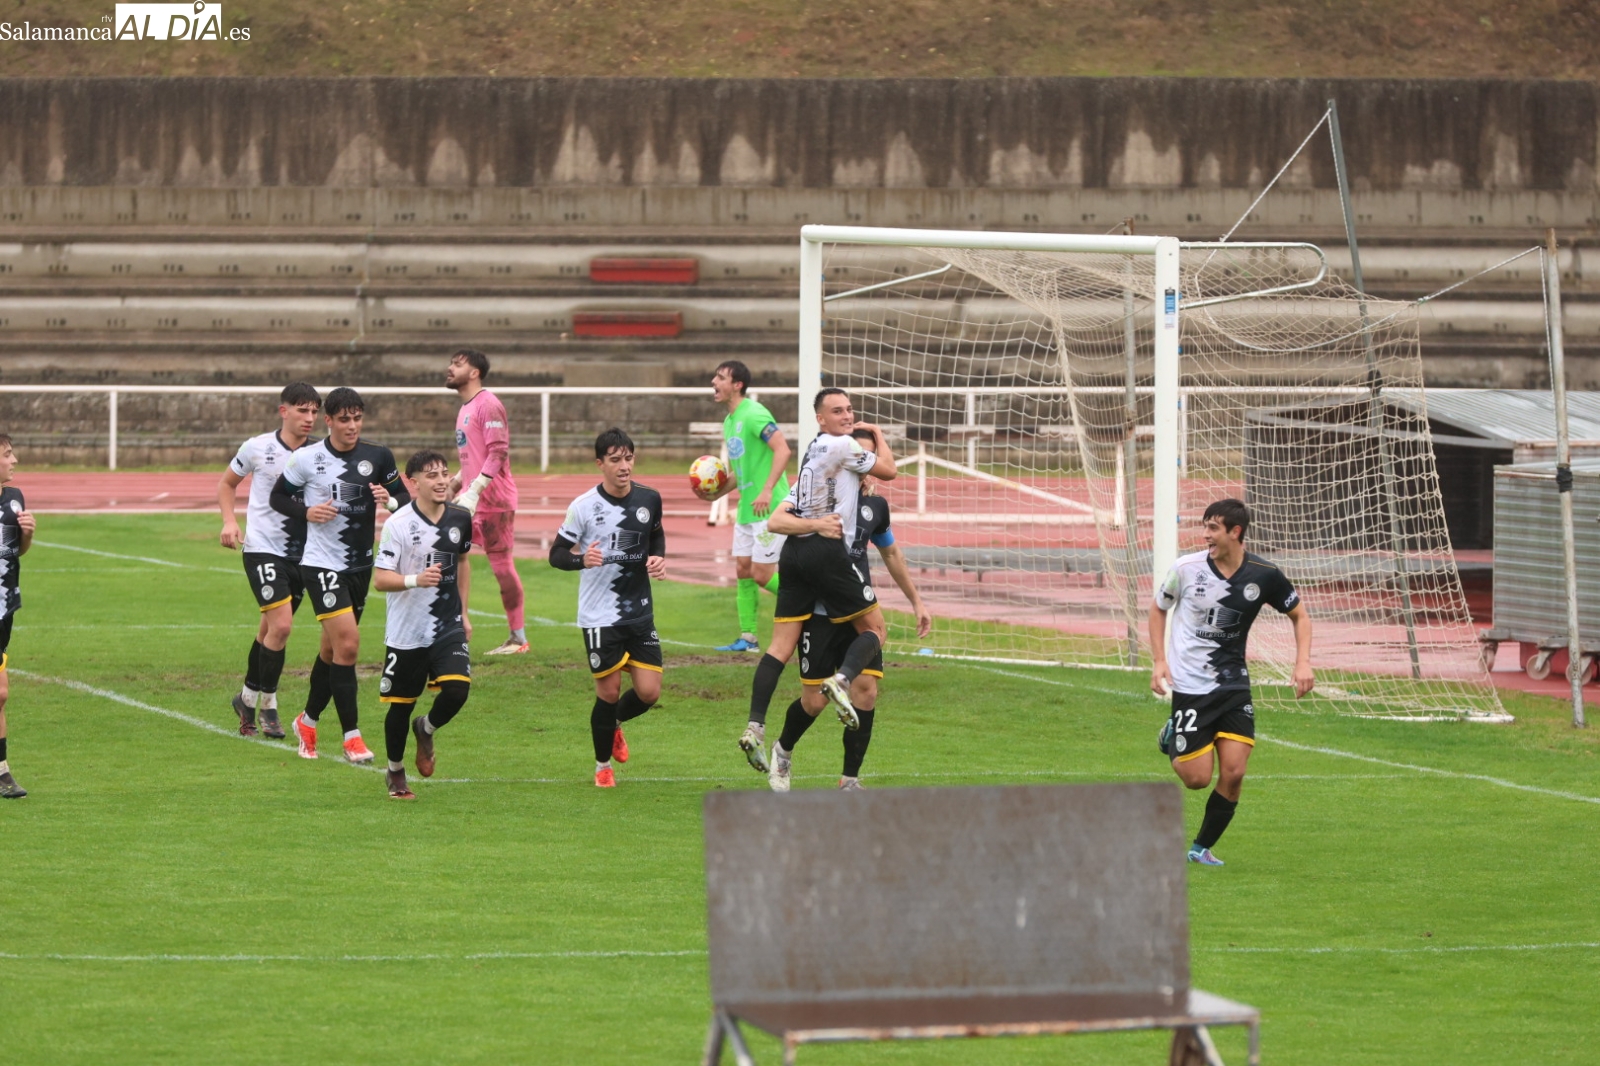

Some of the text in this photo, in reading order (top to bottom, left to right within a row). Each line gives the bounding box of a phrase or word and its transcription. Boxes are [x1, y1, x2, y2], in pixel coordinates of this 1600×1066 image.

[257, 563, 276, 583] 15
[317, 571, 339, 591] 12
[587, 627, 600, 649] 11
[802, 632, 810, 654] 5
[385, 652, 397, 675] 2
[1175, 709, 1198, 733] 22
